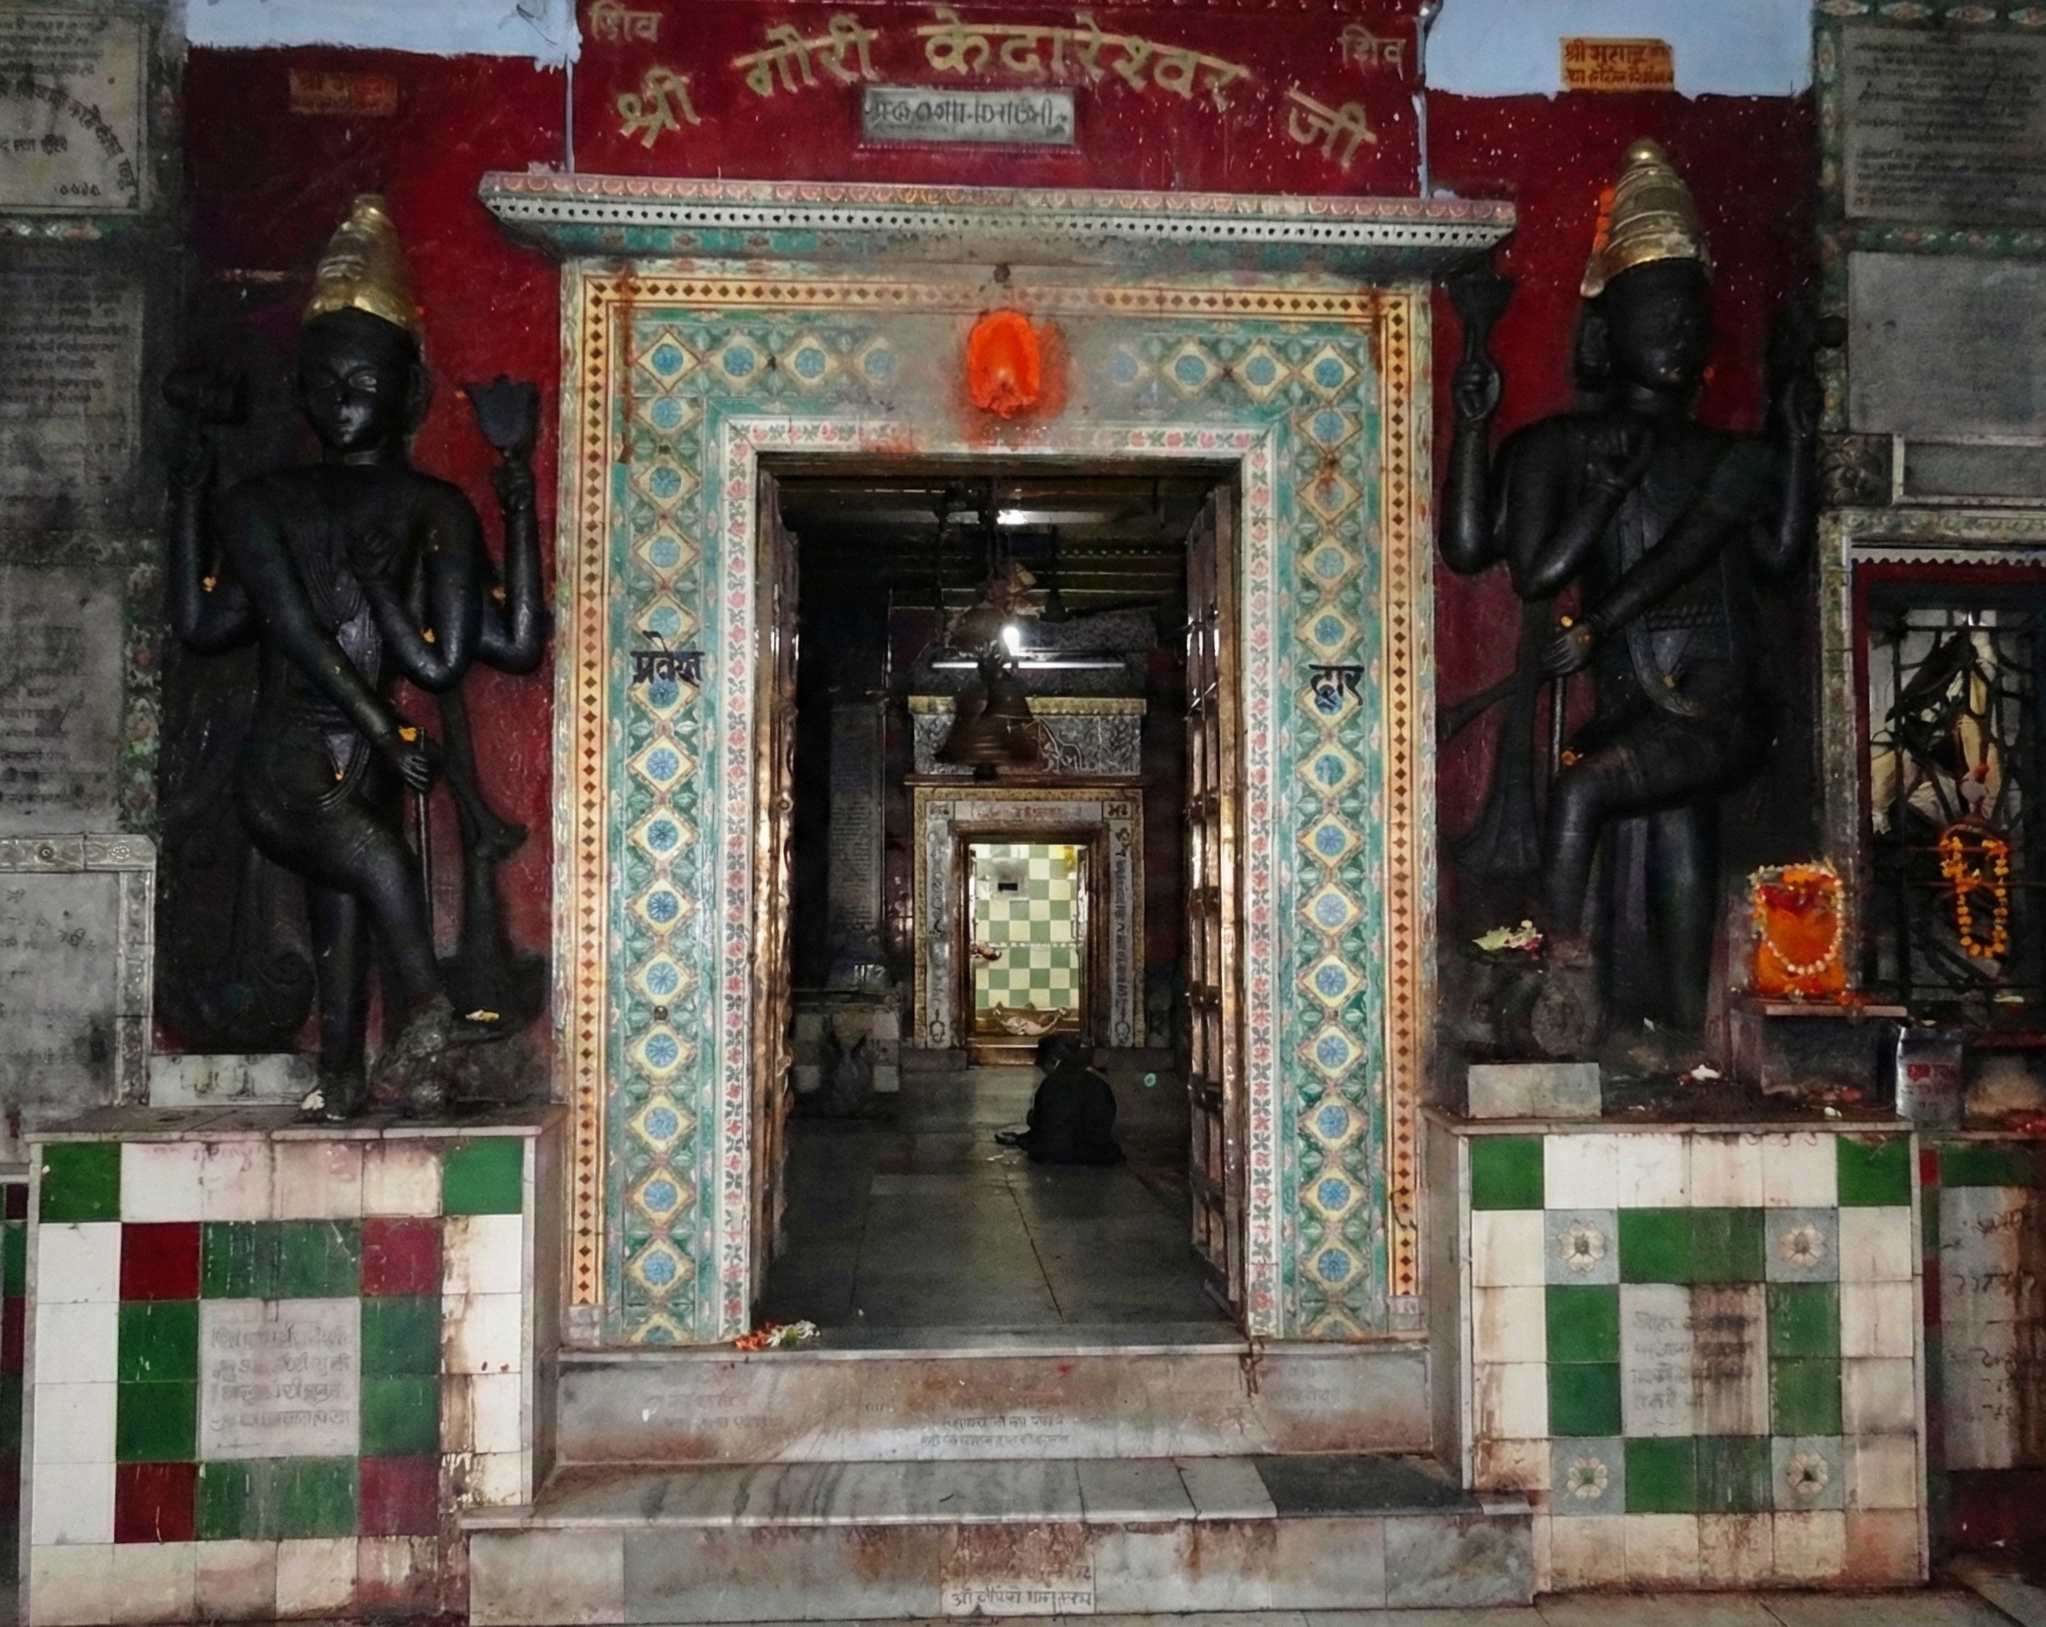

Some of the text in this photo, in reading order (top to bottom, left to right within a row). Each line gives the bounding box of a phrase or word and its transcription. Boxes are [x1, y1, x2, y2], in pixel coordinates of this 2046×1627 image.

[588, 3, 662, 42] शिव
[1337, 23, 1406, 81] शिव
[617, 7, 1378, 172] श्री गौरी केदारेश्वर जी
